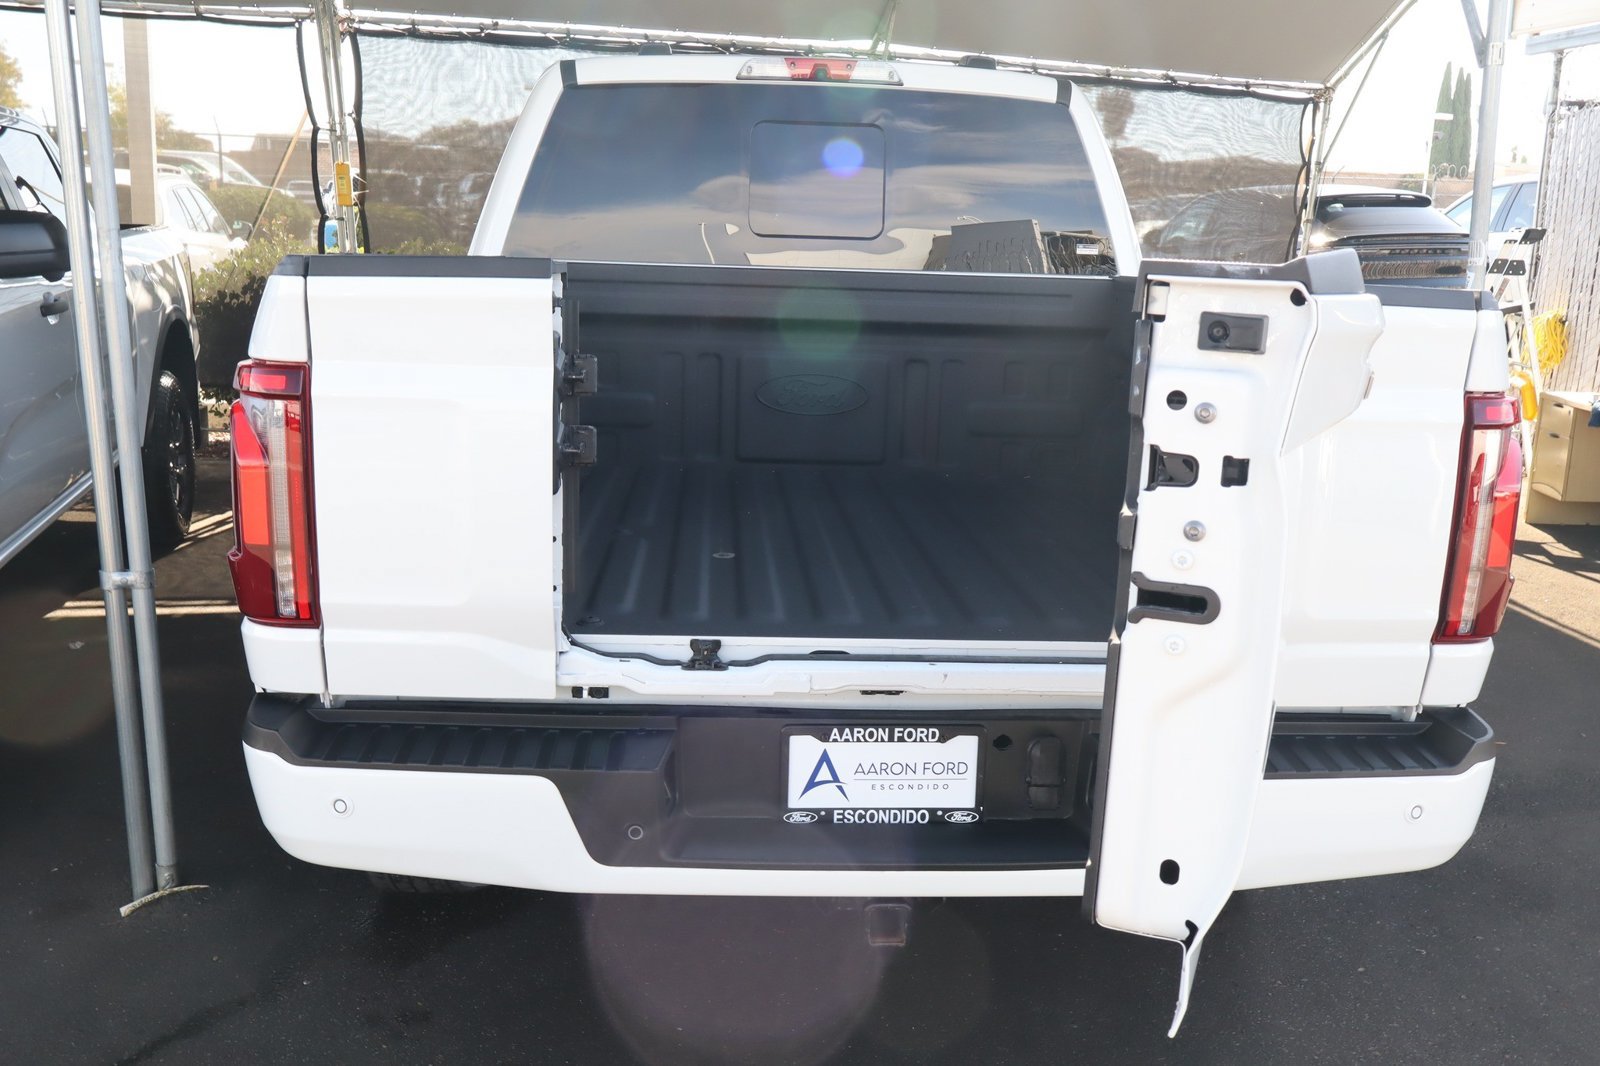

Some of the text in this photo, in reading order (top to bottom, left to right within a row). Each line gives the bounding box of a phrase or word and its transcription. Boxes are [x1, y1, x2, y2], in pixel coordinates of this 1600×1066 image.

[829, 728, 939, 742] AARON FORD
[854, 761, 968, 776] AARON FORD
[789, 811, 812, 823] Ford
[833, 809, 929, 824] ESCONDIDO
[950, 811, 973, 822] Ford
